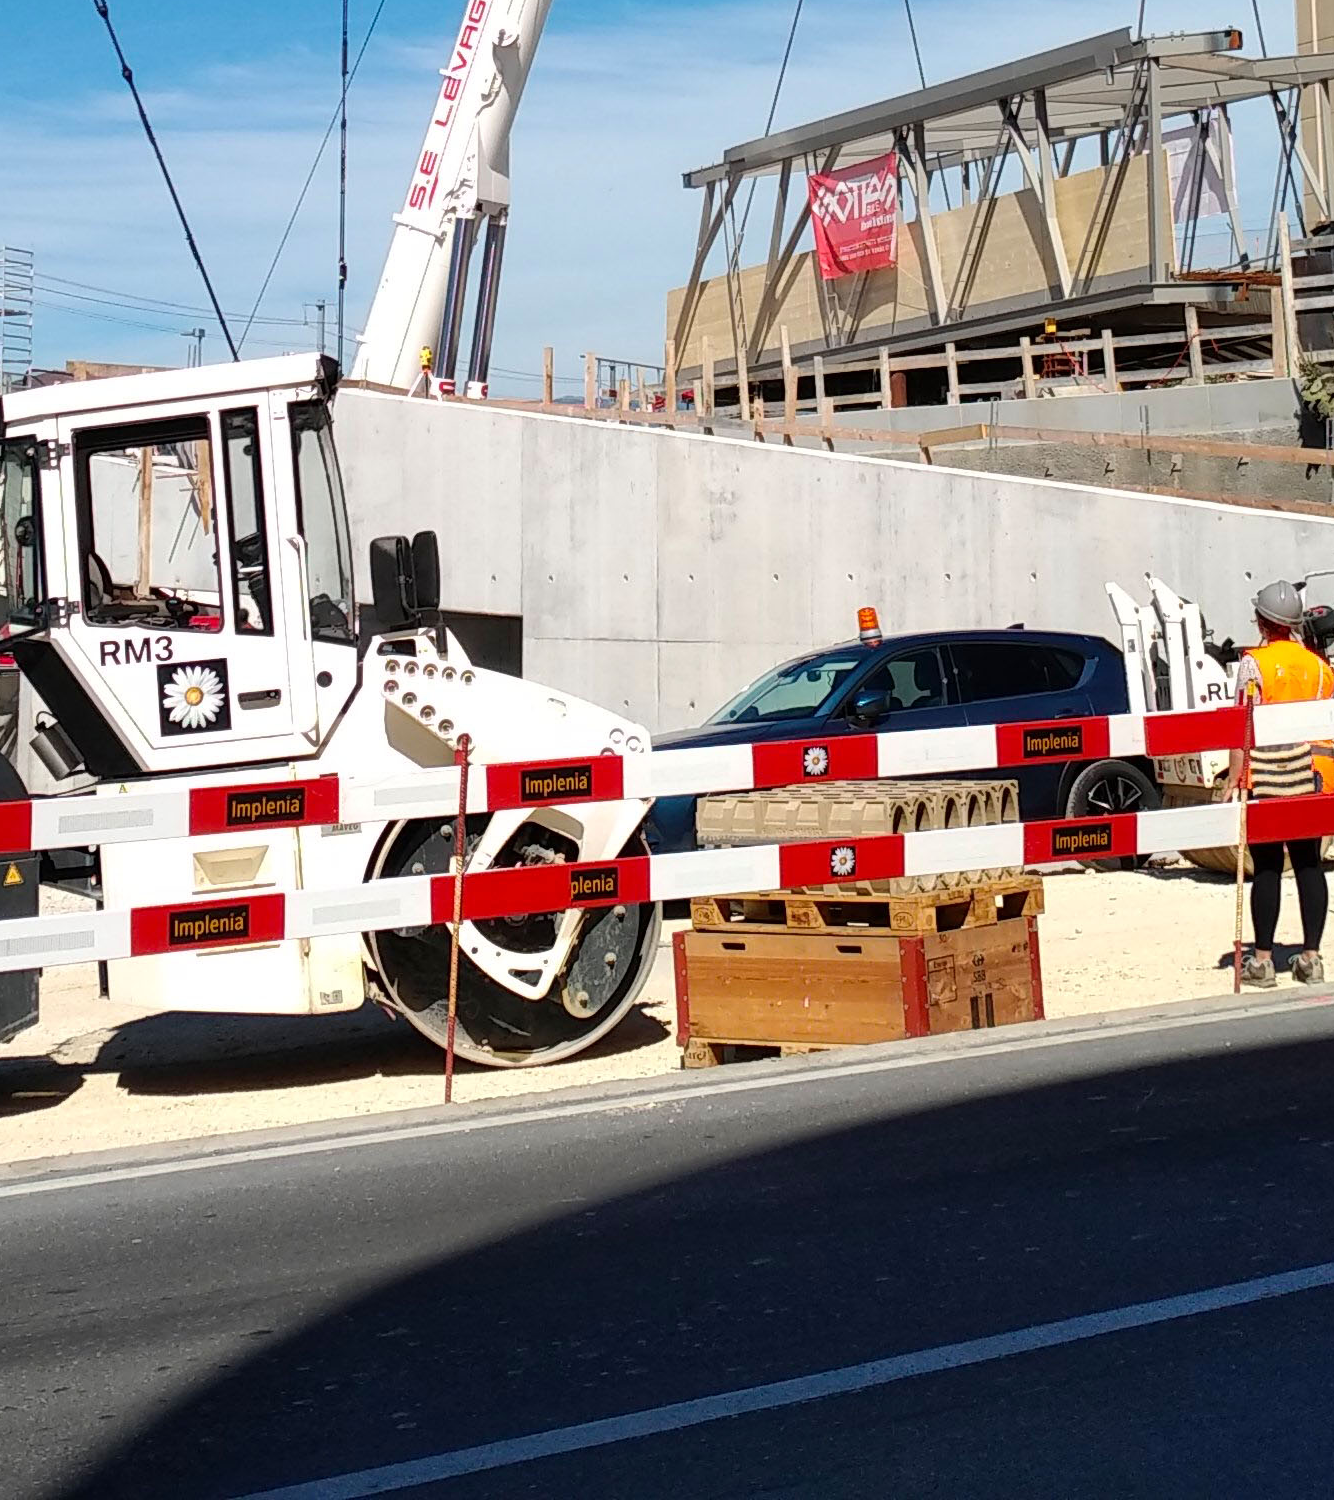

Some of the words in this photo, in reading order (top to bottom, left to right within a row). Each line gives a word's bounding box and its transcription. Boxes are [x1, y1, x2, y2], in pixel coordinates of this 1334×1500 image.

[99, 636, 174, 667] RM3
[1027, 732, 1079, 754] Implenia
[526, 772, 589, 797] Implenia
[232, 795, 301, 821] Implenia
[1056, 829, 1109, 853] Implenia
[571, 874, 615, 899] plenia
[174, 913, 245, 940] Implenia
